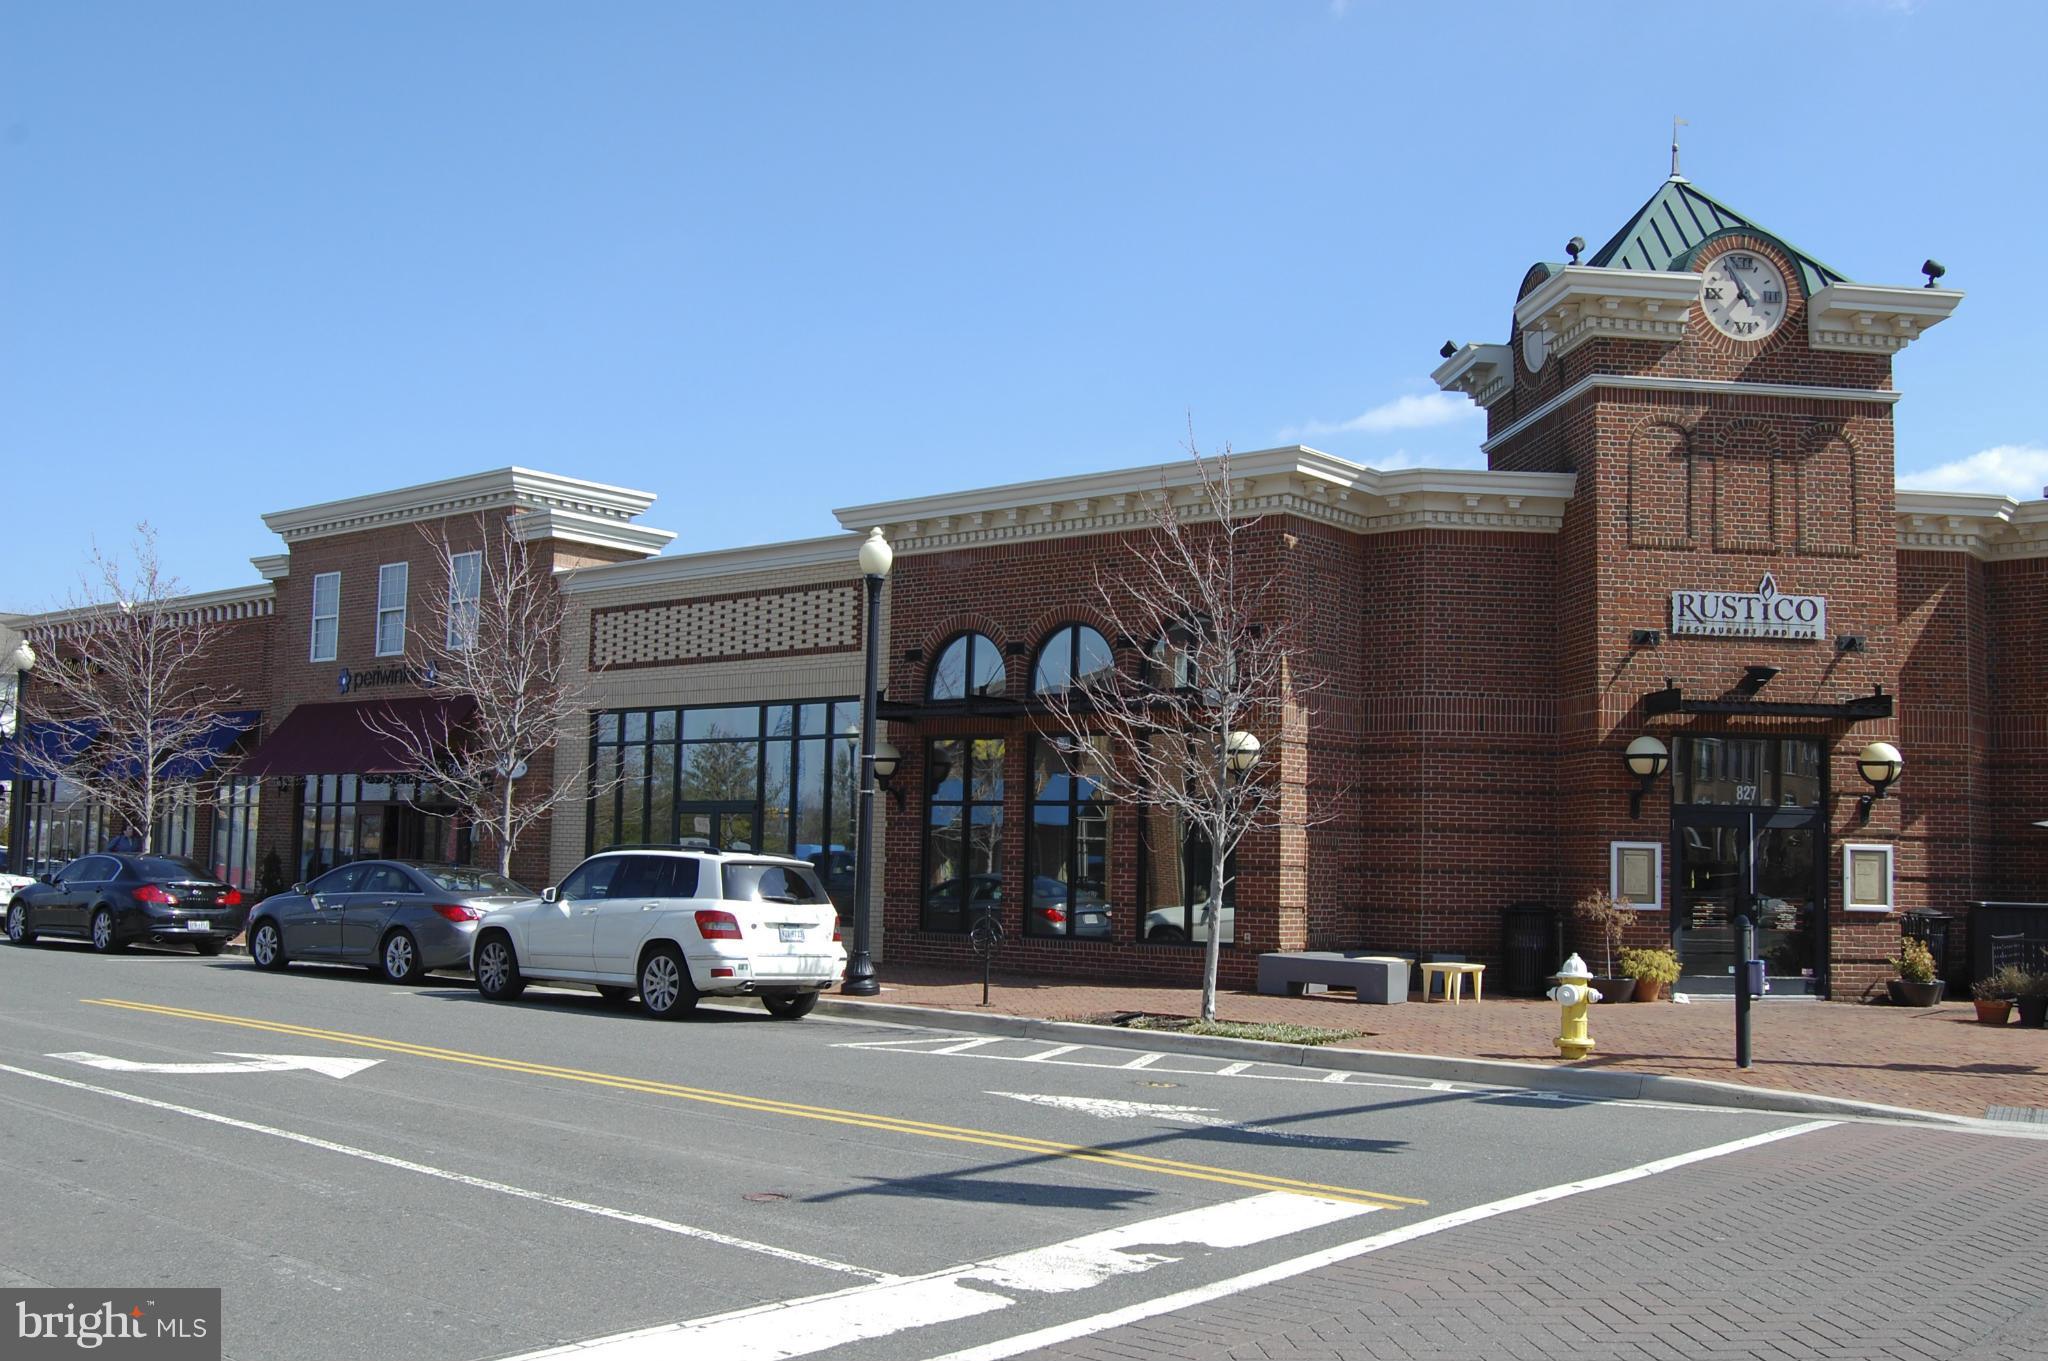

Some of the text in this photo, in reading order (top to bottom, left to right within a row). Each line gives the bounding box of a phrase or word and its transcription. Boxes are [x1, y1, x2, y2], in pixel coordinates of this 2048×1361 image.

[1704, 287, 1724, 300] IX
[1763, 290, 1783, 304] III
[1734, 321, 1753, 334] VI
[1677, 625, 1817, 638] RESTAURANT AND BAR
[354, 663, 422, 692] periwink
[1736, 785, 1757, 800] 827
